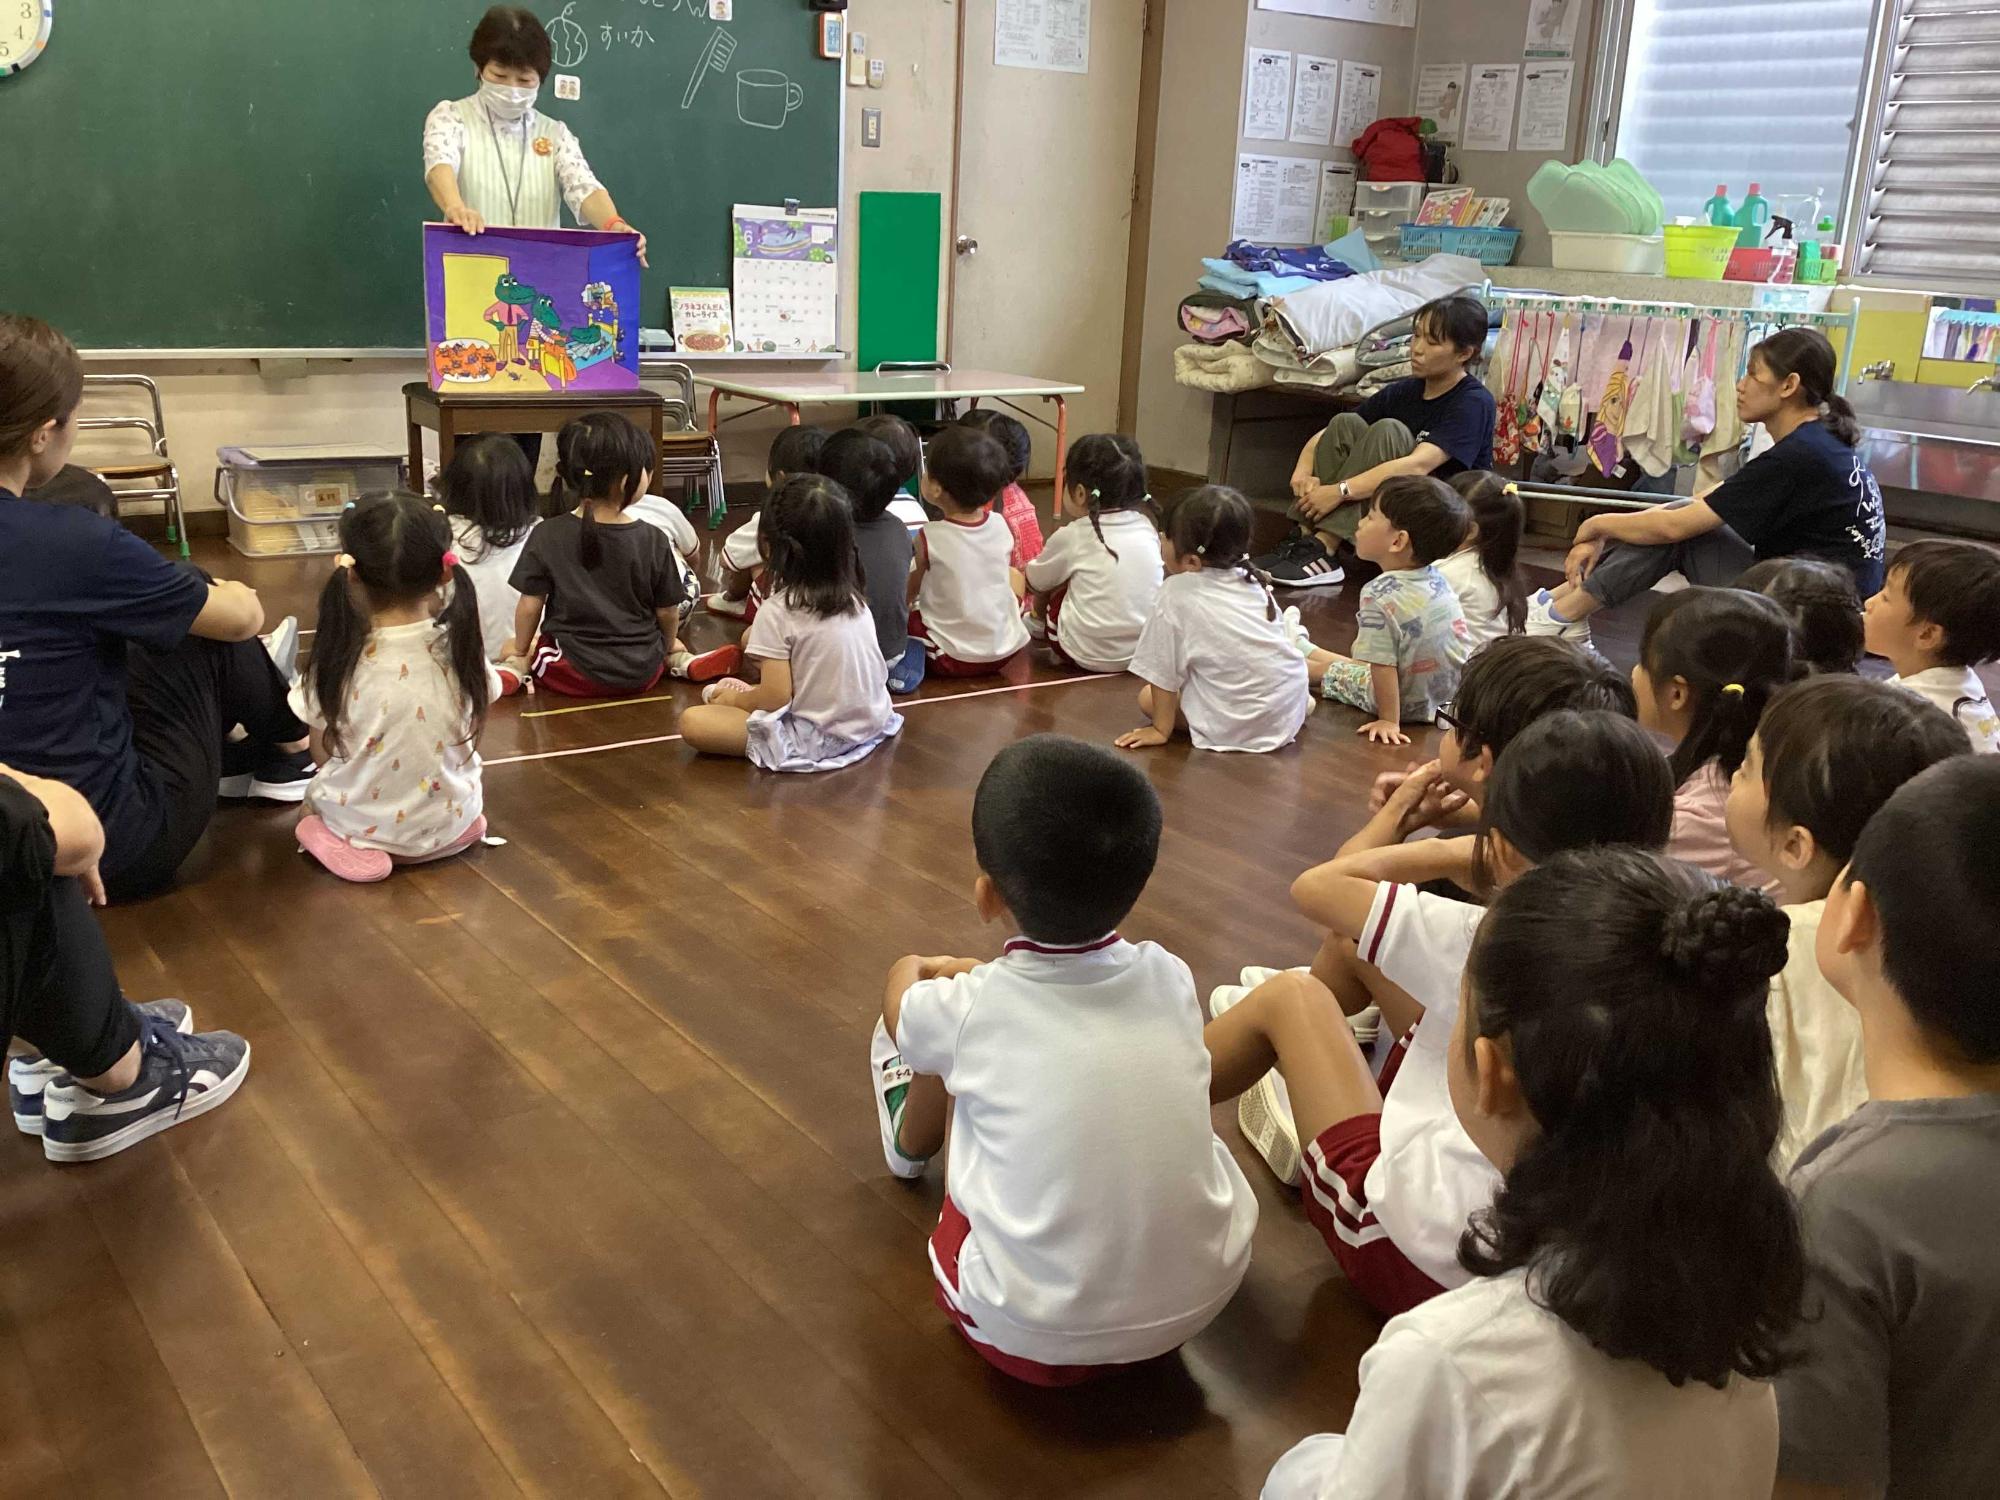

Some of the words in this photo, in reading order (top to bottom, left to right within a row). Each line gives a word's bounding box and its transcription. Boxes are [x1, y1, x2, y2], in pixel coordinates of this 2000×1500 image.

[20, 2, 31, 19] 3
[13, 25, 24, 40] 4
[600, 22, 655, 51] すいか
[743, 230, 753, 244] 6
